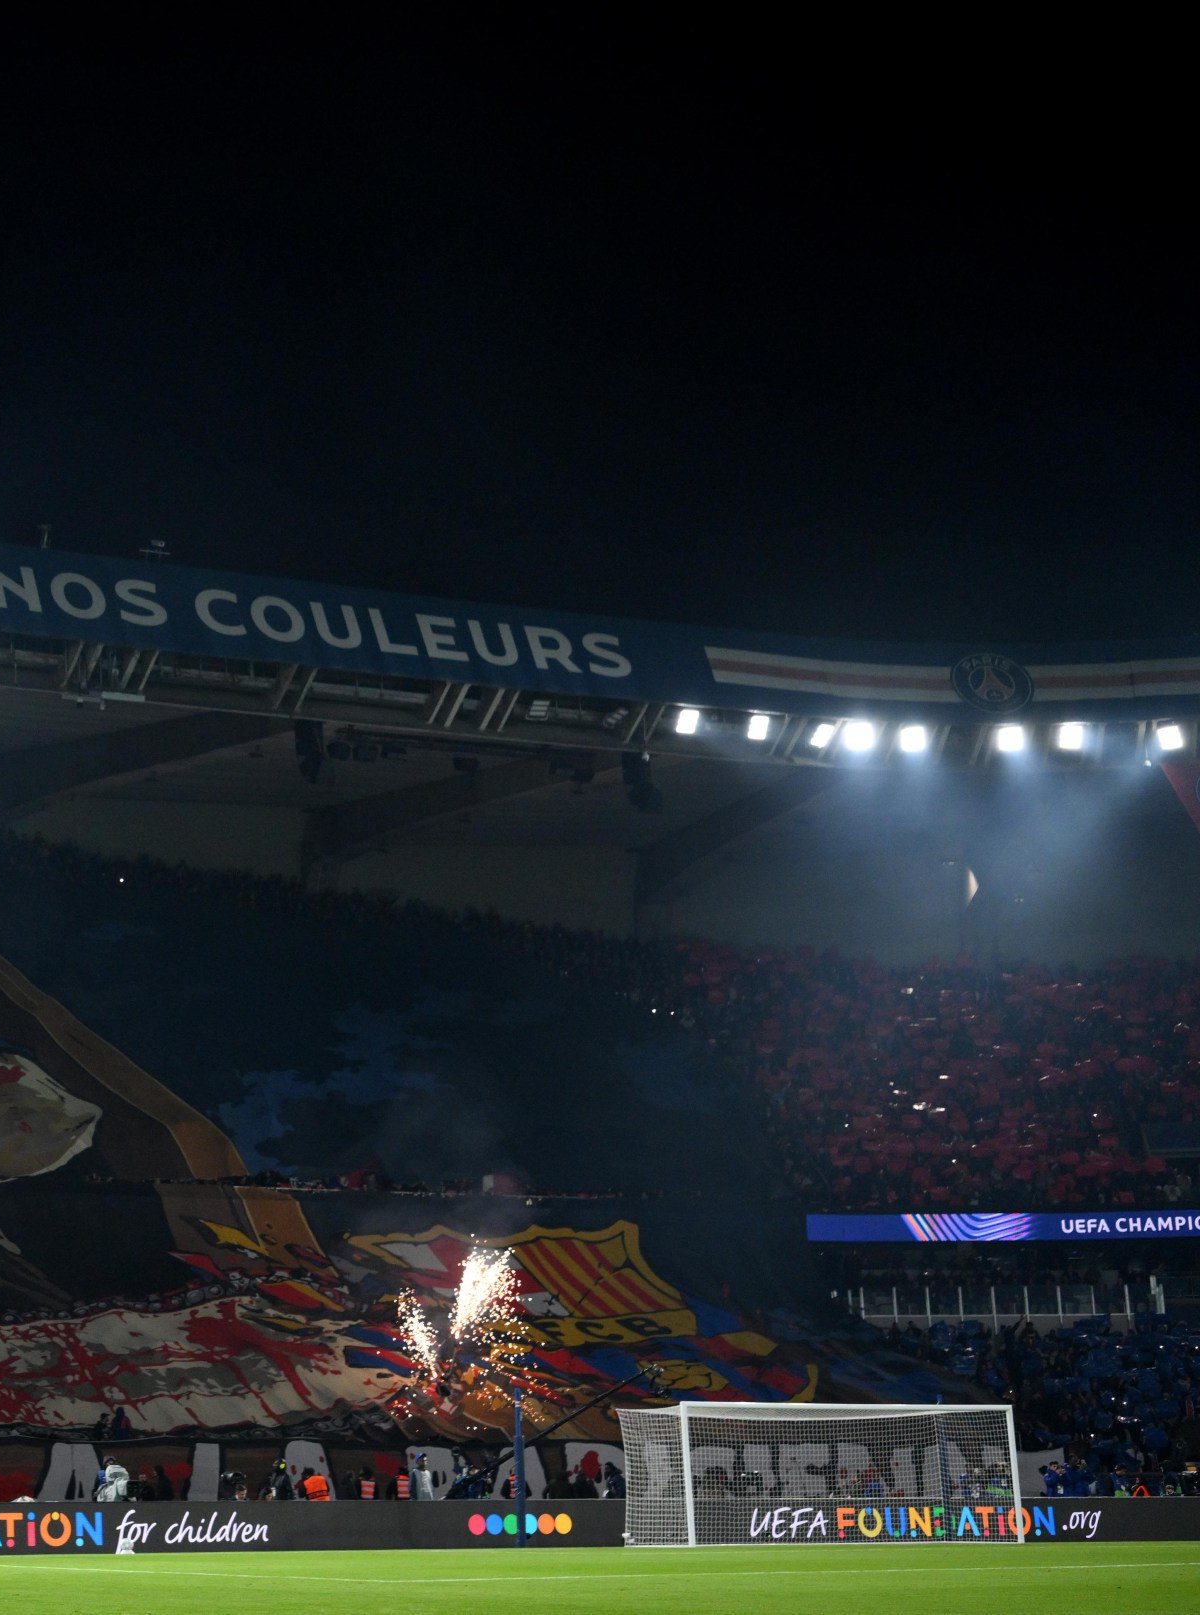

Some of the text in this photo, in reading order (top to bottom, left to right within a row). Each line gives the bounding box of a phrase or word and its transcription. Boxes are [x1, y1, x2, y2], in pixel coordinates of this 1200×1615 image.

[194, 588, 633, 678] COULEURS
[1061, 1218, 1111, 1234] UEFA
[115, 1509, 157, 1554] for
[164, 1510, 270, 1545] children
[749, 1506, 829, 1539] UEFA
